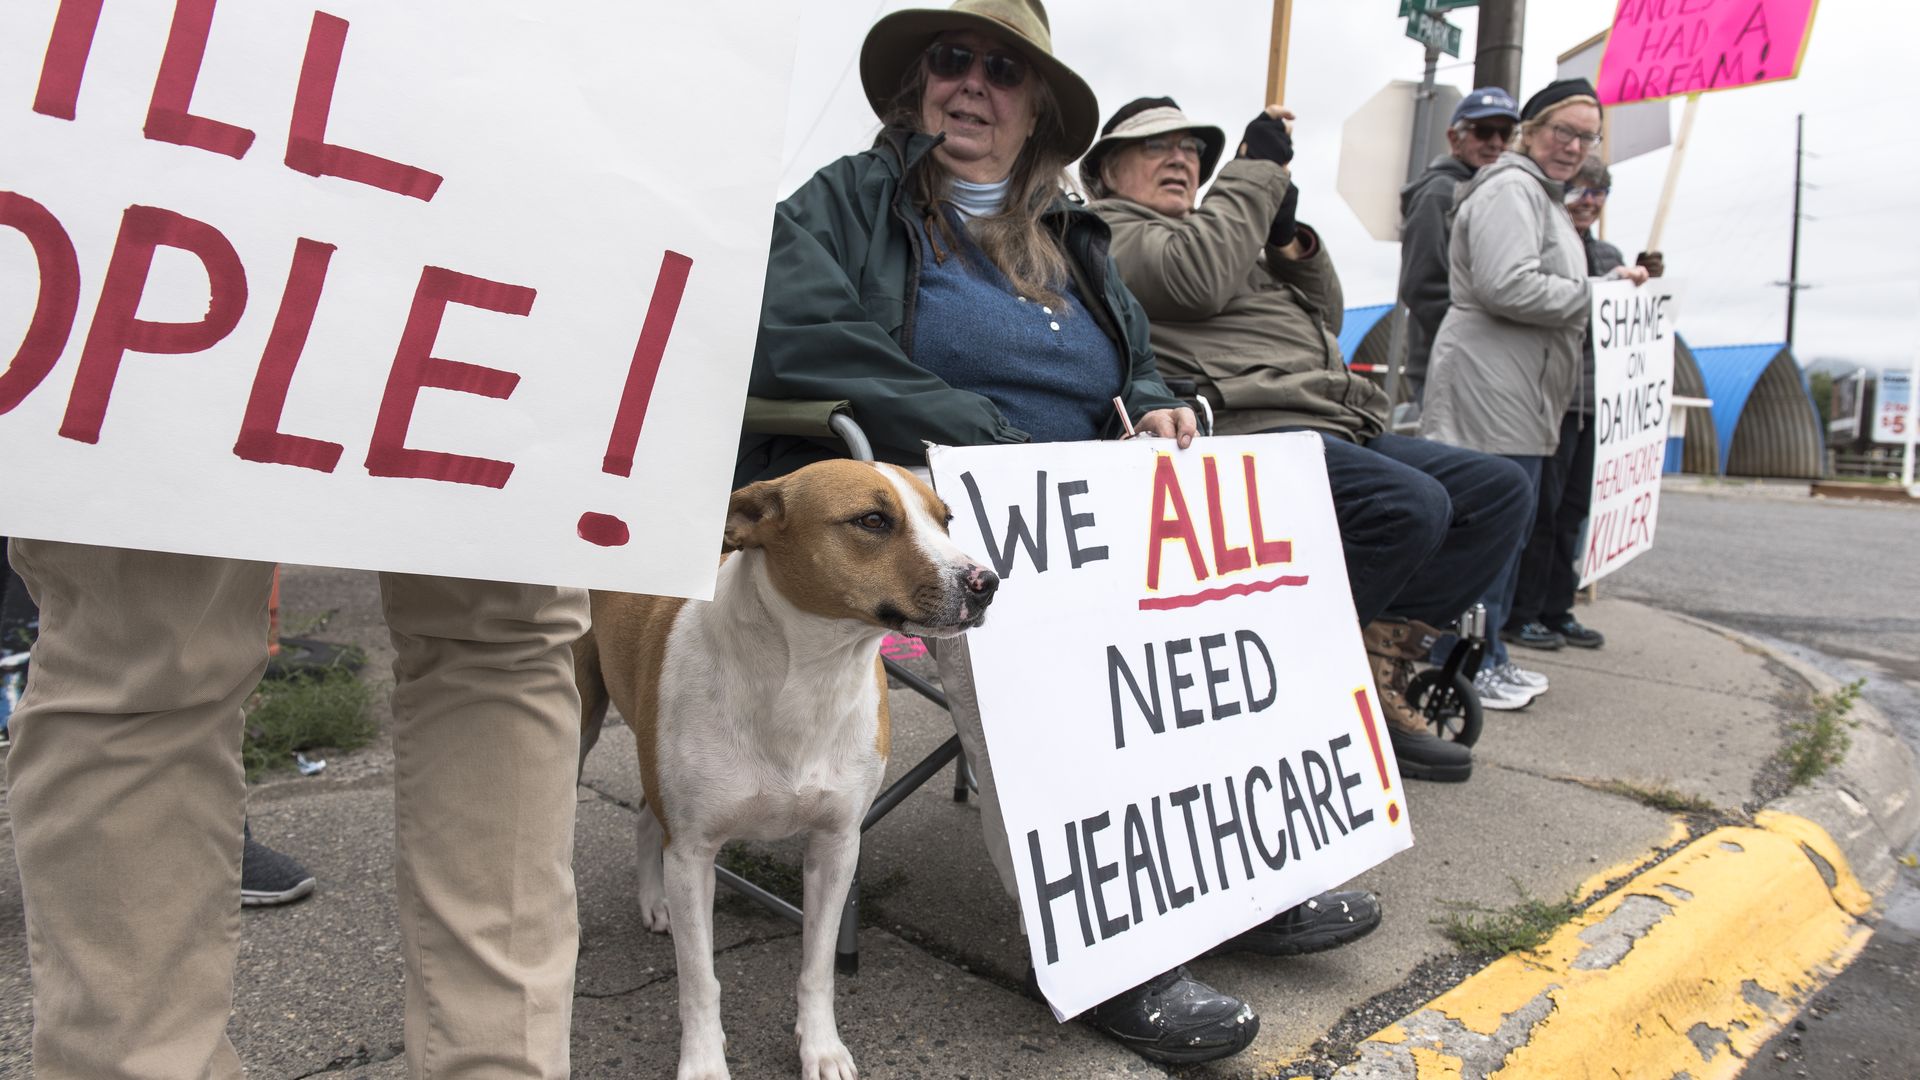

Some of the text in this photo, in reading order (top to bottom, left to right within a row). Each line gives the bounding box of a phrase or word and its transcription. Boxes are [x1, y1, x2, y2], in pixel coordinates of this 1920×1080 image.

[1637, 2, 1770, 62] HAD A
[1600, 294, 1671, 348] SHAME
[1626, 352, 1646, 379] ON
[1600, 379, 1667, 445] DAINES
[1594, 440, 1663, 503] HEALTHCARE
[960, 451, 1293, 591] WE ALL
[1584, 492, 1650, 578] KILLER
[1107, 629, 1278, 749] NEED
